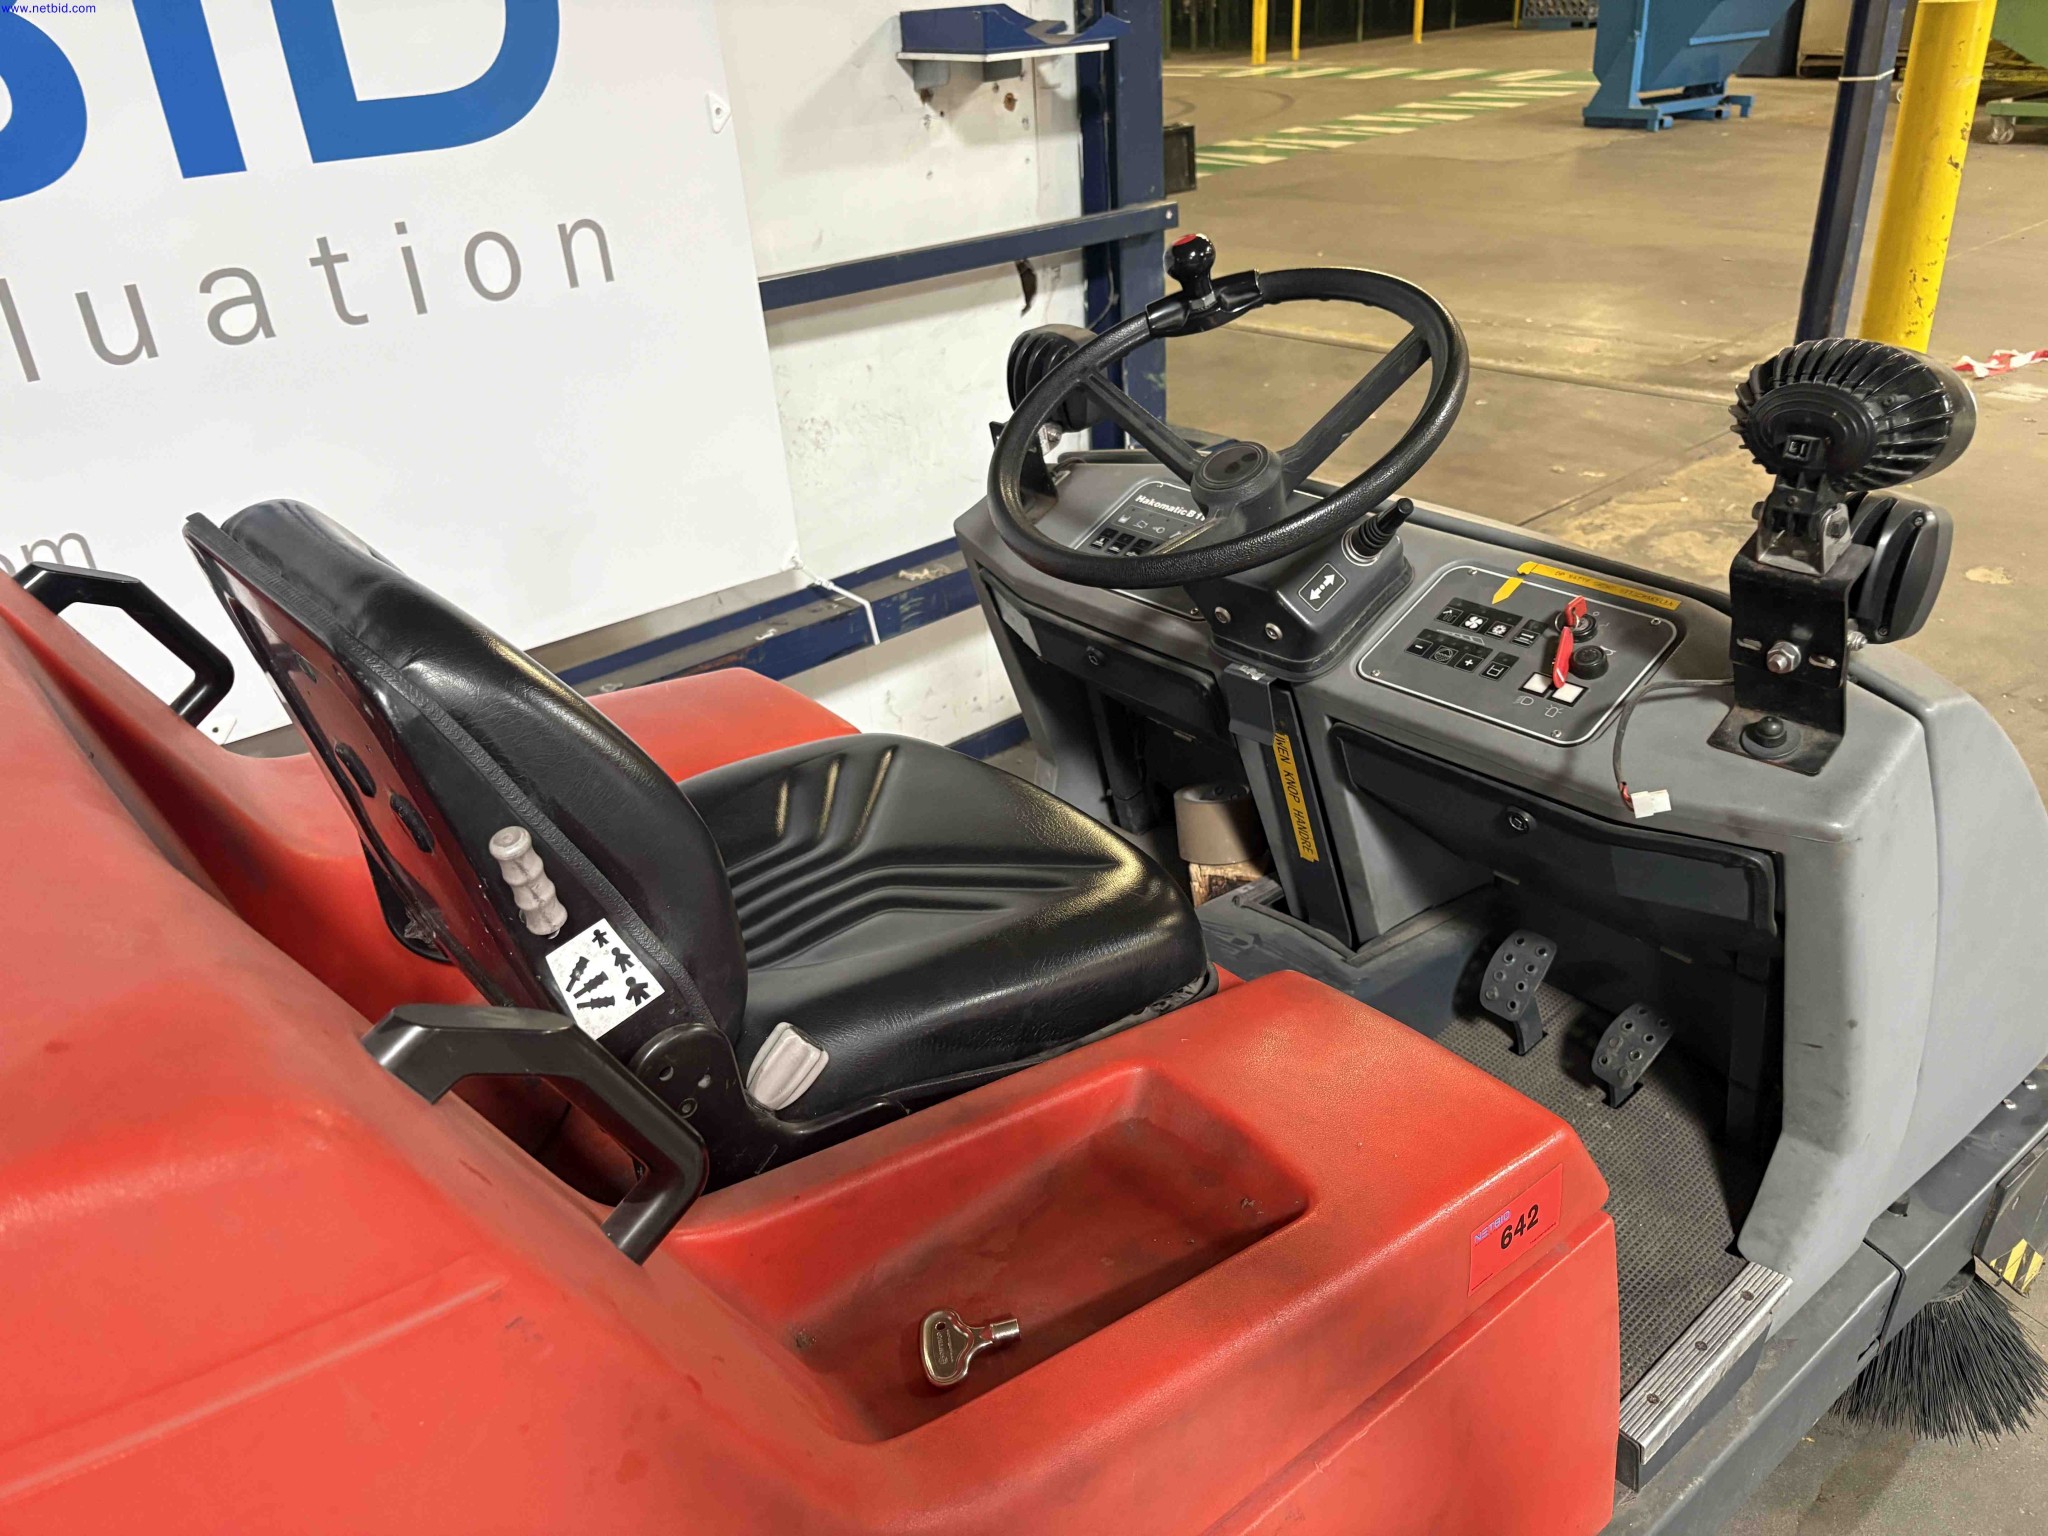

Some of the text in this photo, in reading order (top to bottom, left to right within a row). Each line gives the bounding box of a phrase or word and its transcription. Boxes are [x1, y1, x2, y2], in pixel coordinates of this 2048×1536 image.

[0, 217, 616, 383] luation
[1135, 494, 1188, 516] Hakomatic
[1283, 769, 1301, 804] KNOP
[1474, 1209, 1511, 1244] NETBID
[1500, 1203, 1539, 1250] 642
